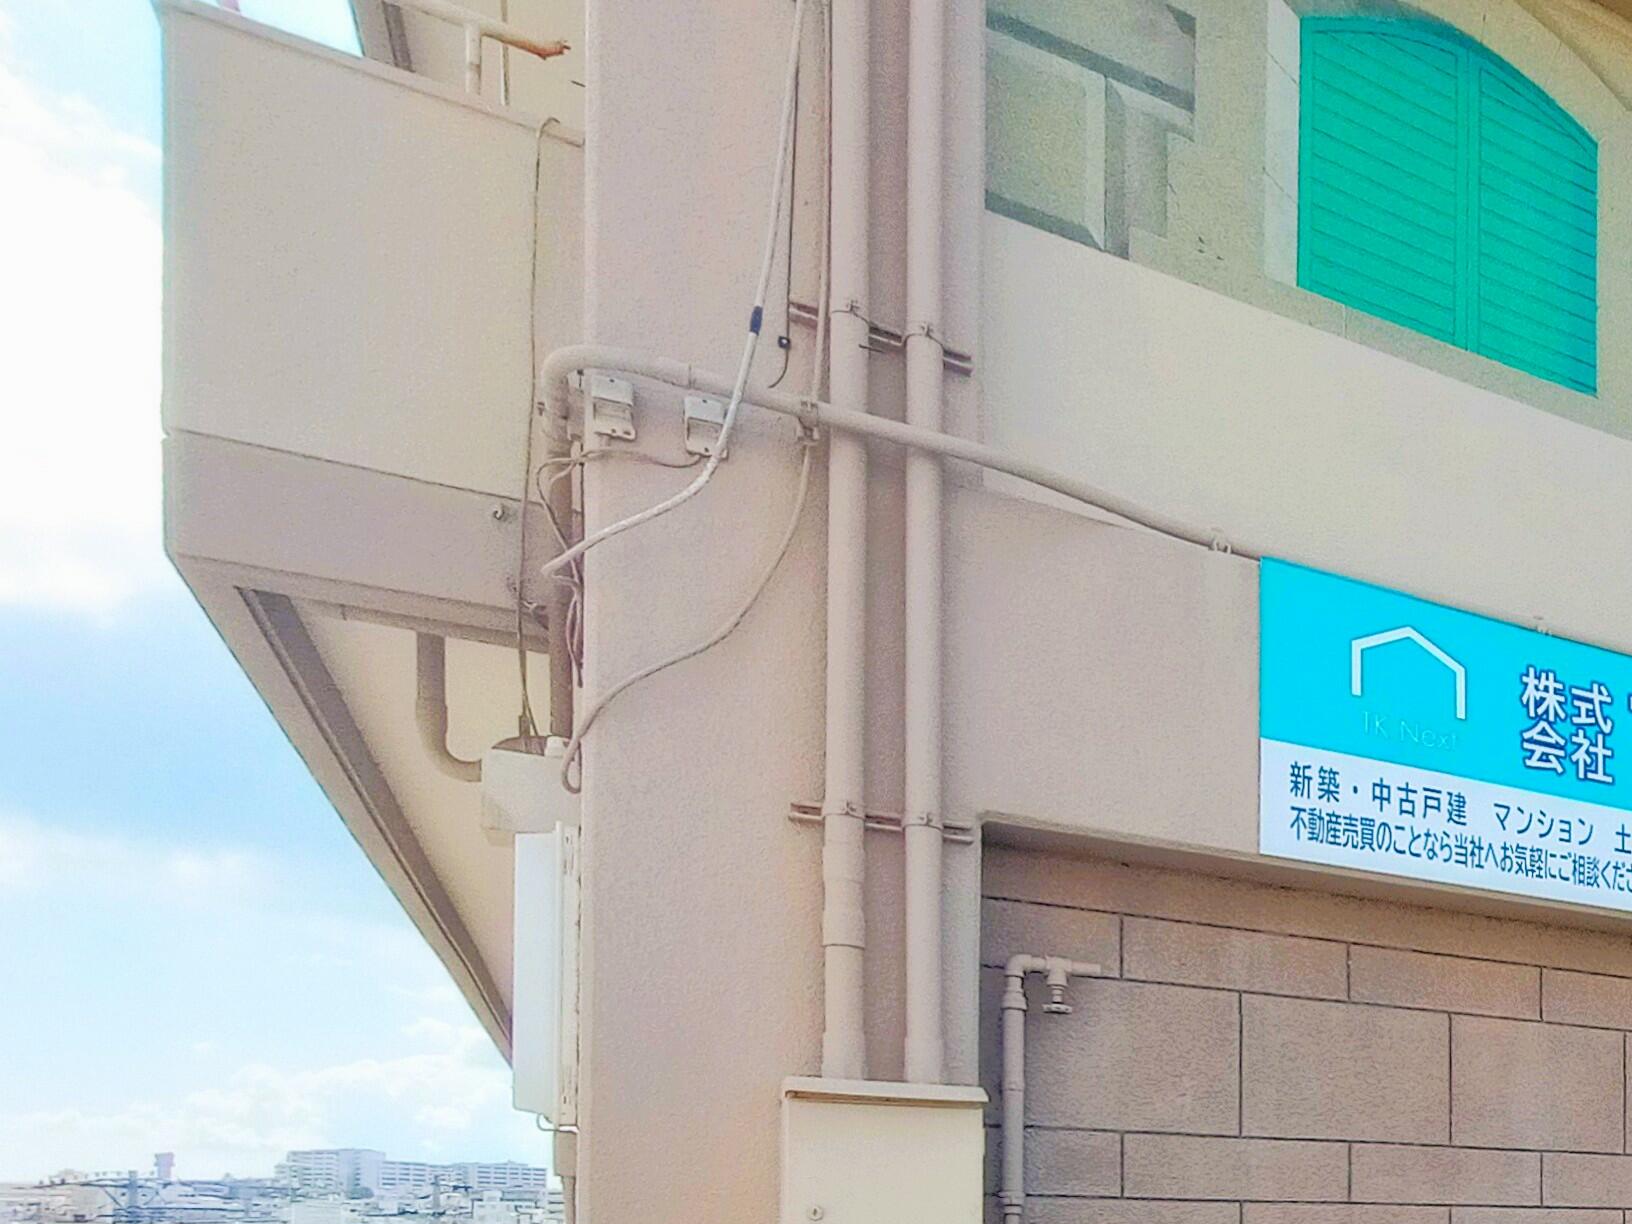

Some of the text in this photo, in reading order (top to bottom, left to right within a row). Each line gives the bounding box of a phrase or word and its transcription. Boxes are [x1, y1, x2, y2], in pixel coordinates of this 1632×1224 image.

[1521, 666, 1612, 734] 株式
[1362, 711, 1457, 752] TK Next
[1522, 723, 1614, 784] 会社
[1494, 802, 1595, 847] マンション
